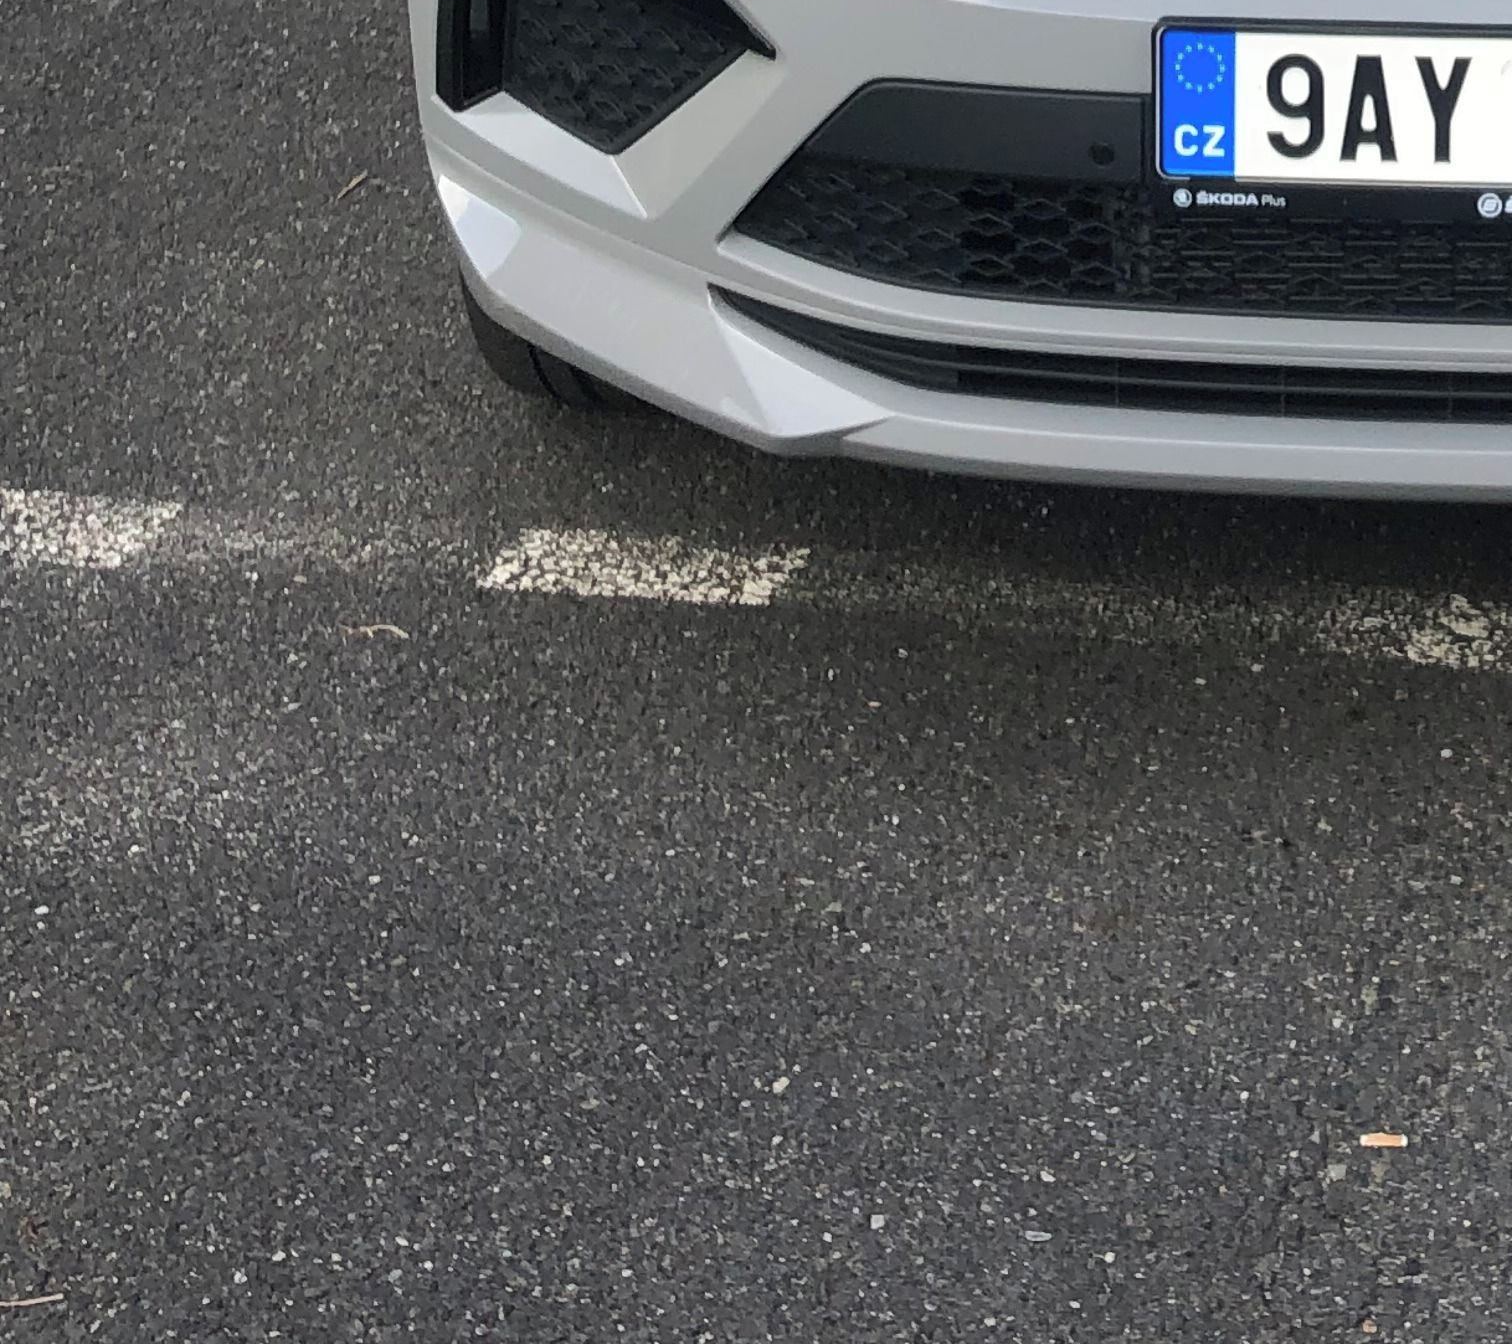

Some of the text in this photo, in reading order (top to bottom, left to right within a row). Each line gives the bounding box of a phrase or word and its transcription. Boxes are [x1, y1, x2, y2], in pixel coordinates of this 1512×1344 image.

[1265, 53, 1473, 164] 9AY
[1173, 124, 1226, 157] CZ
[1196, 190, 1286, 207] ŠKODA Plus
